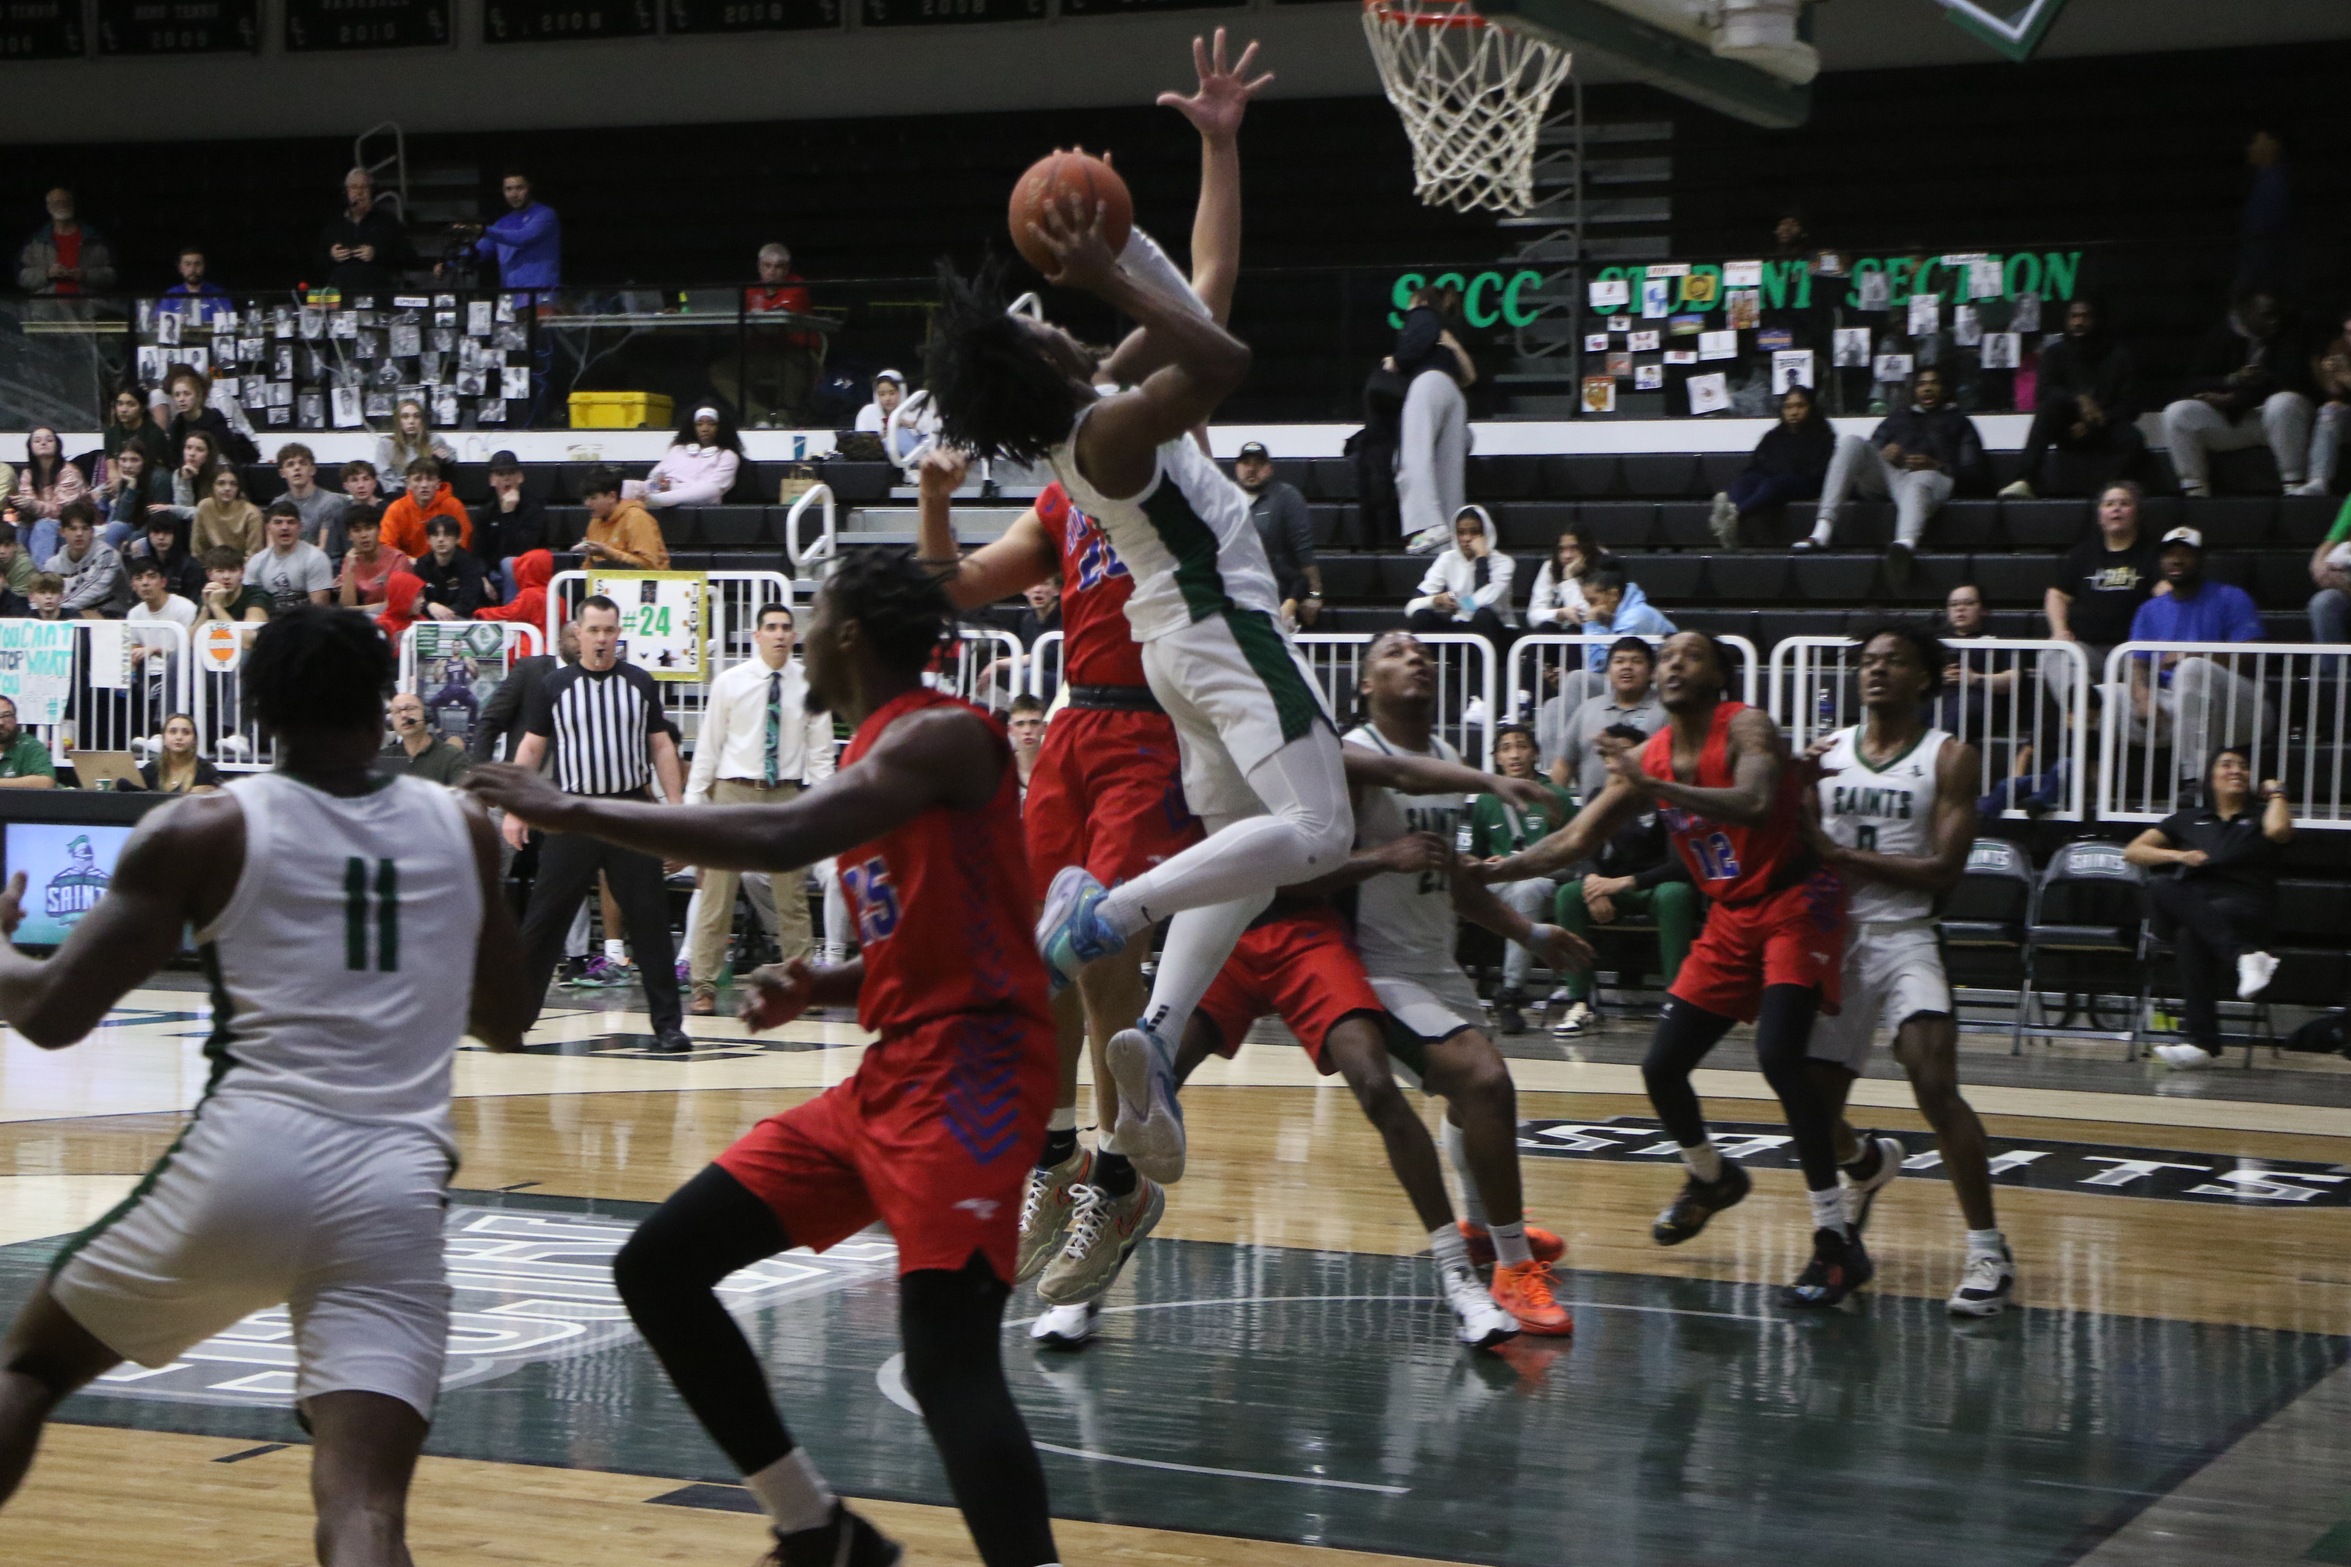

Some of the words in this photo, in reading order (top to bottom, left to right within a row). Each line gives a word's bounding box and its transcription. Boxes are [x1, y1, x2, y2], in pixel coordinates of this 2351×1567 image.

[1592, 259, 1812, 315] STUDNT
[1845, 251, 2083, 310] SECTON
[622, 605, 672, 638] #24
[0, 650, 23, 671] TOP
[1833, 786, 1914, 820] SAINTS
[1688, 831, 1741, 881] 12
[48, 884, 109, 914] SAINT
[343, 856, 399, 974] 11
[1518, 1122, 2348, 1203] SANTS
